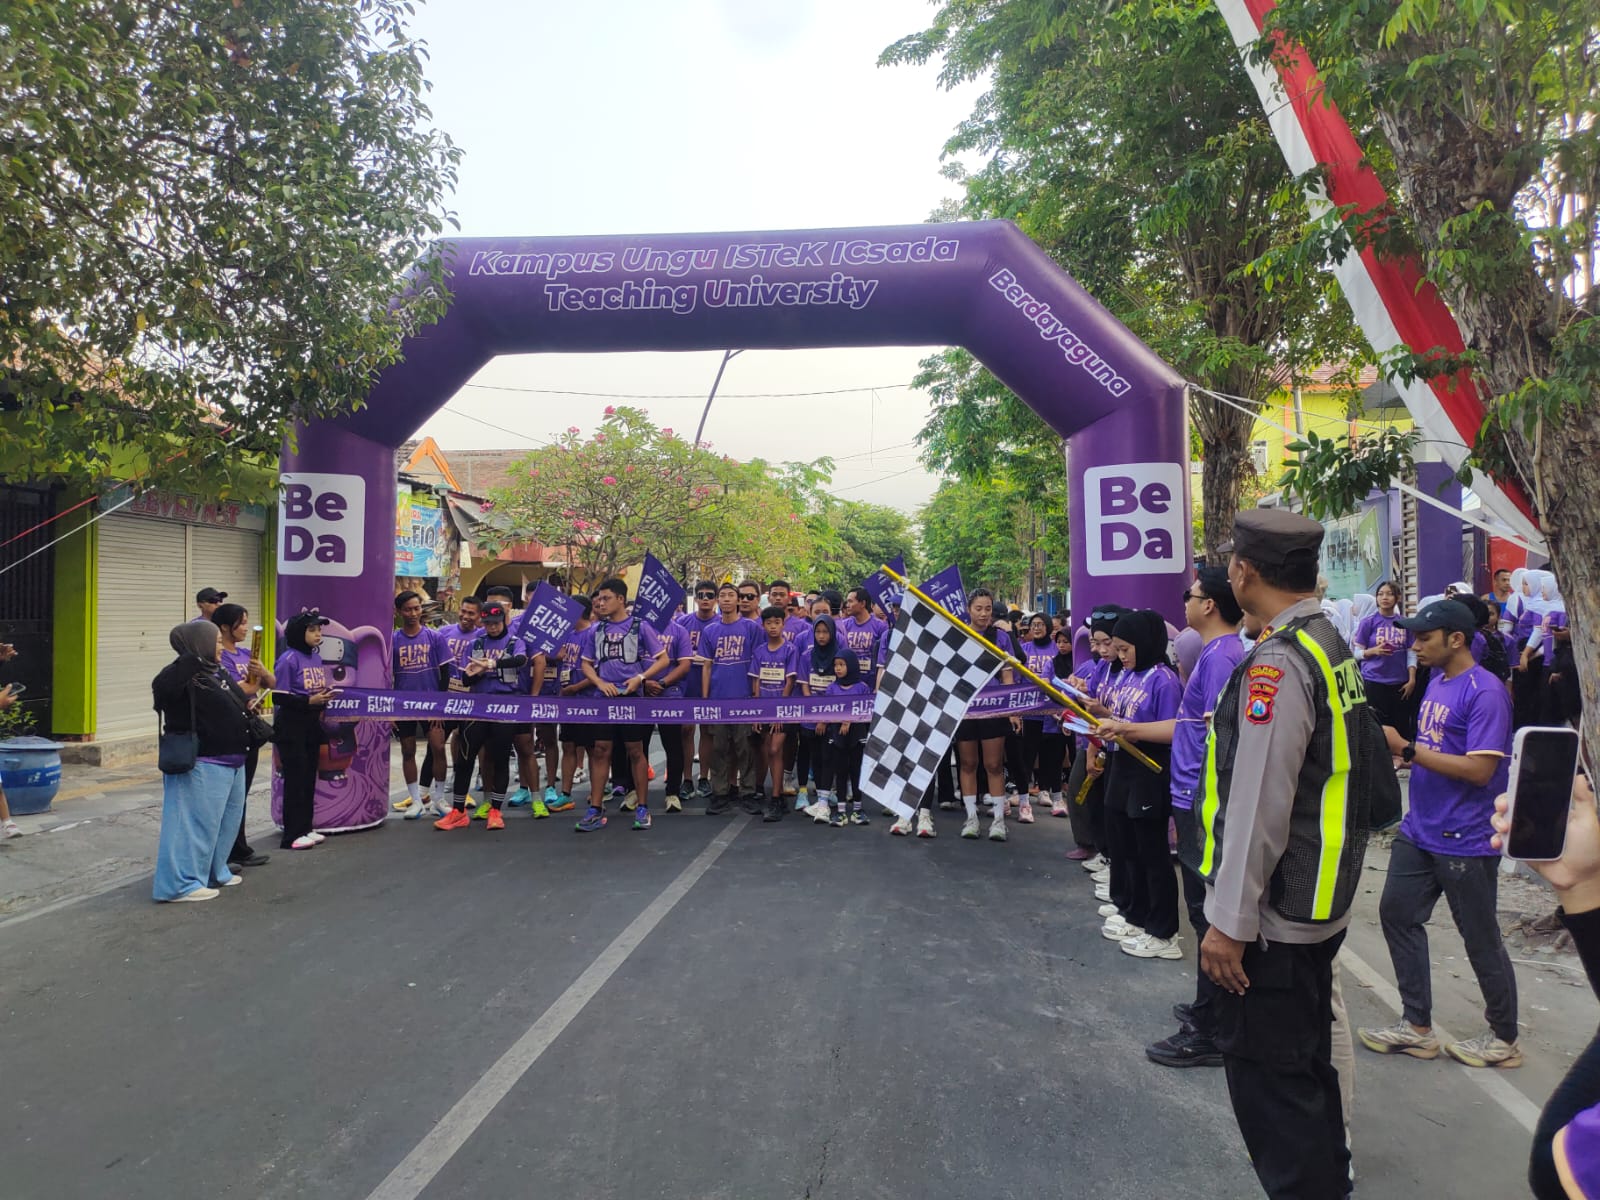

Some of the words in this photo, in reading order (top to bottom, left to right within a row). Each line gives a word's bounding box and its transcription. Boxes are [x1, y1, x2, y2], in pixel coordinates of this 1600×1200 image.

[469, 251, 615, 280] Kampus
[621, 247, 718, 277] Ungu
[723, 241, 828, 269] ISTeK
[830, 236, 959, 265] ICsada
[544, 278, 697, 314] Teaching
[703, 271, 879, 310] University
[988, 268, 1132, 397] Berdayaguna
[285, 483, 348, 522] Be
[1100, 476, 1171, 517] Be
[284, 525, 346, 564] Da
[1100, 521, 1173, 562] Da
[327, 699, 360, 709] START
[403, 701, 437, 710] START
[486, 704, 520, 714] START
[567, 708, 599, 716] START
[651, 709, 684, 717] START
[811, 704, 845, 713] START
